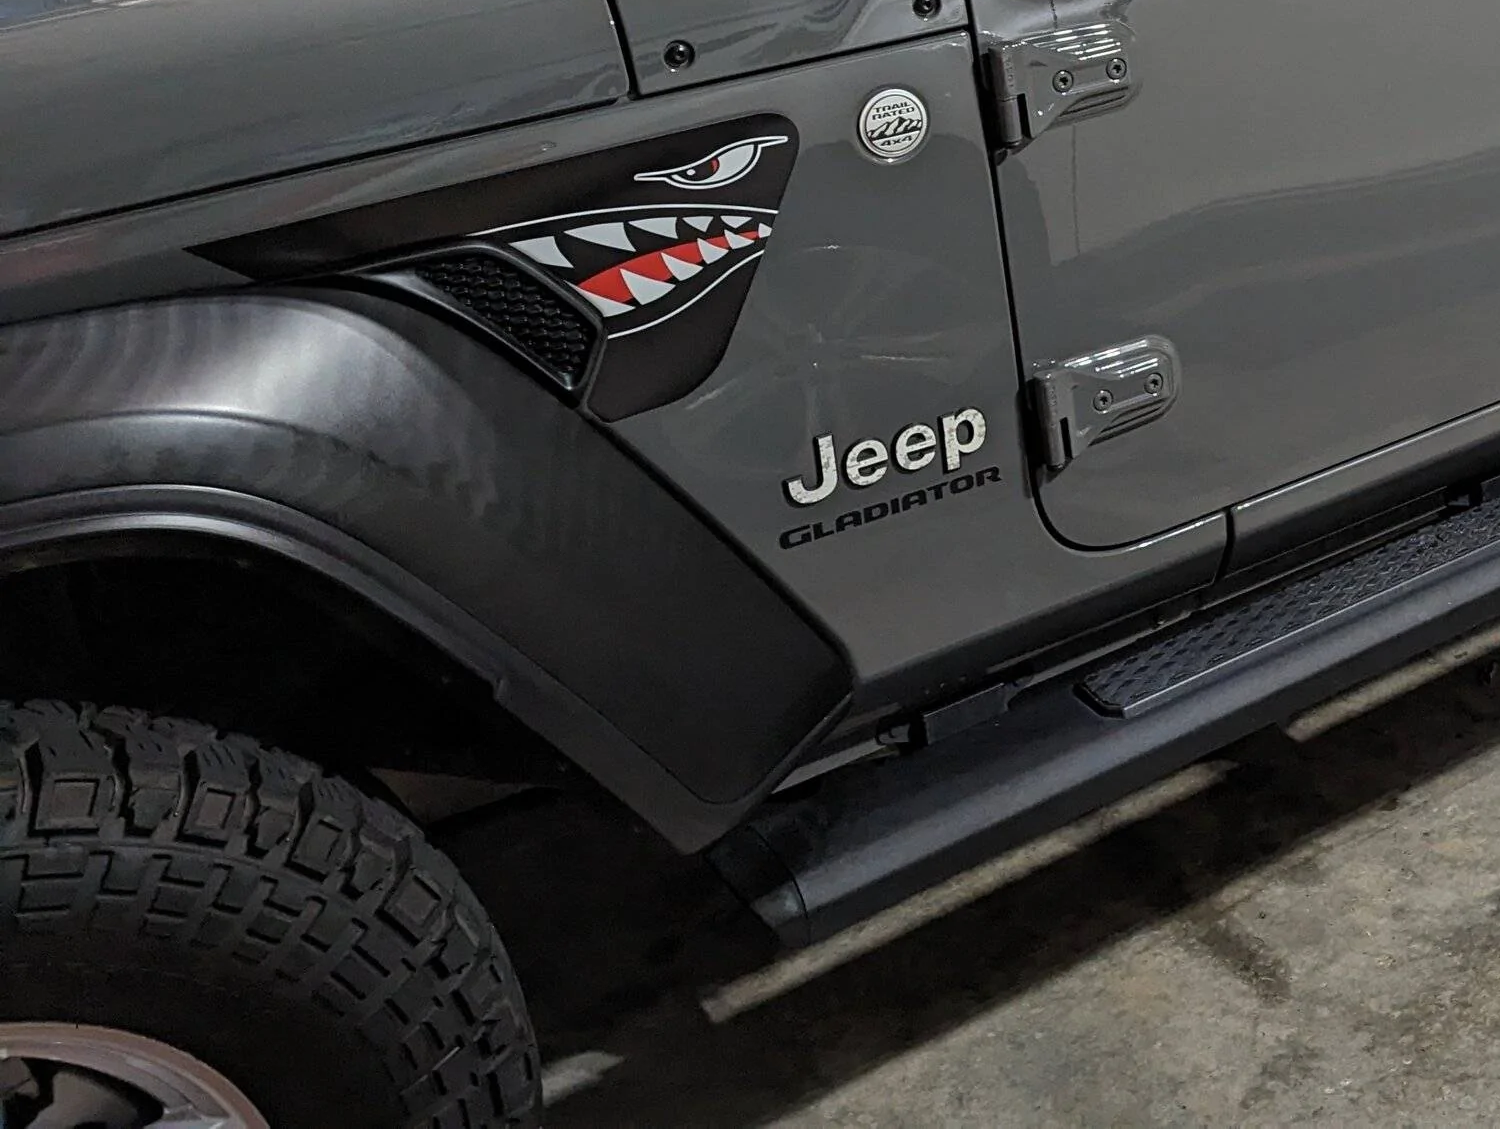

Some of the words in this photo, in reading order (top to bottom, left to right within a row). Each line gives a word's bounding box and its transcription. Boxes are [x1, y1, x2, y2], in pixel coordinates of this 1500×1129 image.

[872, 106, 915, 120] RATED
[873, 101, 911, 113] TRAIL
[880, 135, 913, 147] 4x4
[783, 406, 987, 507] Jeep
[779, 465, 1003, 550] GLADIATOR
